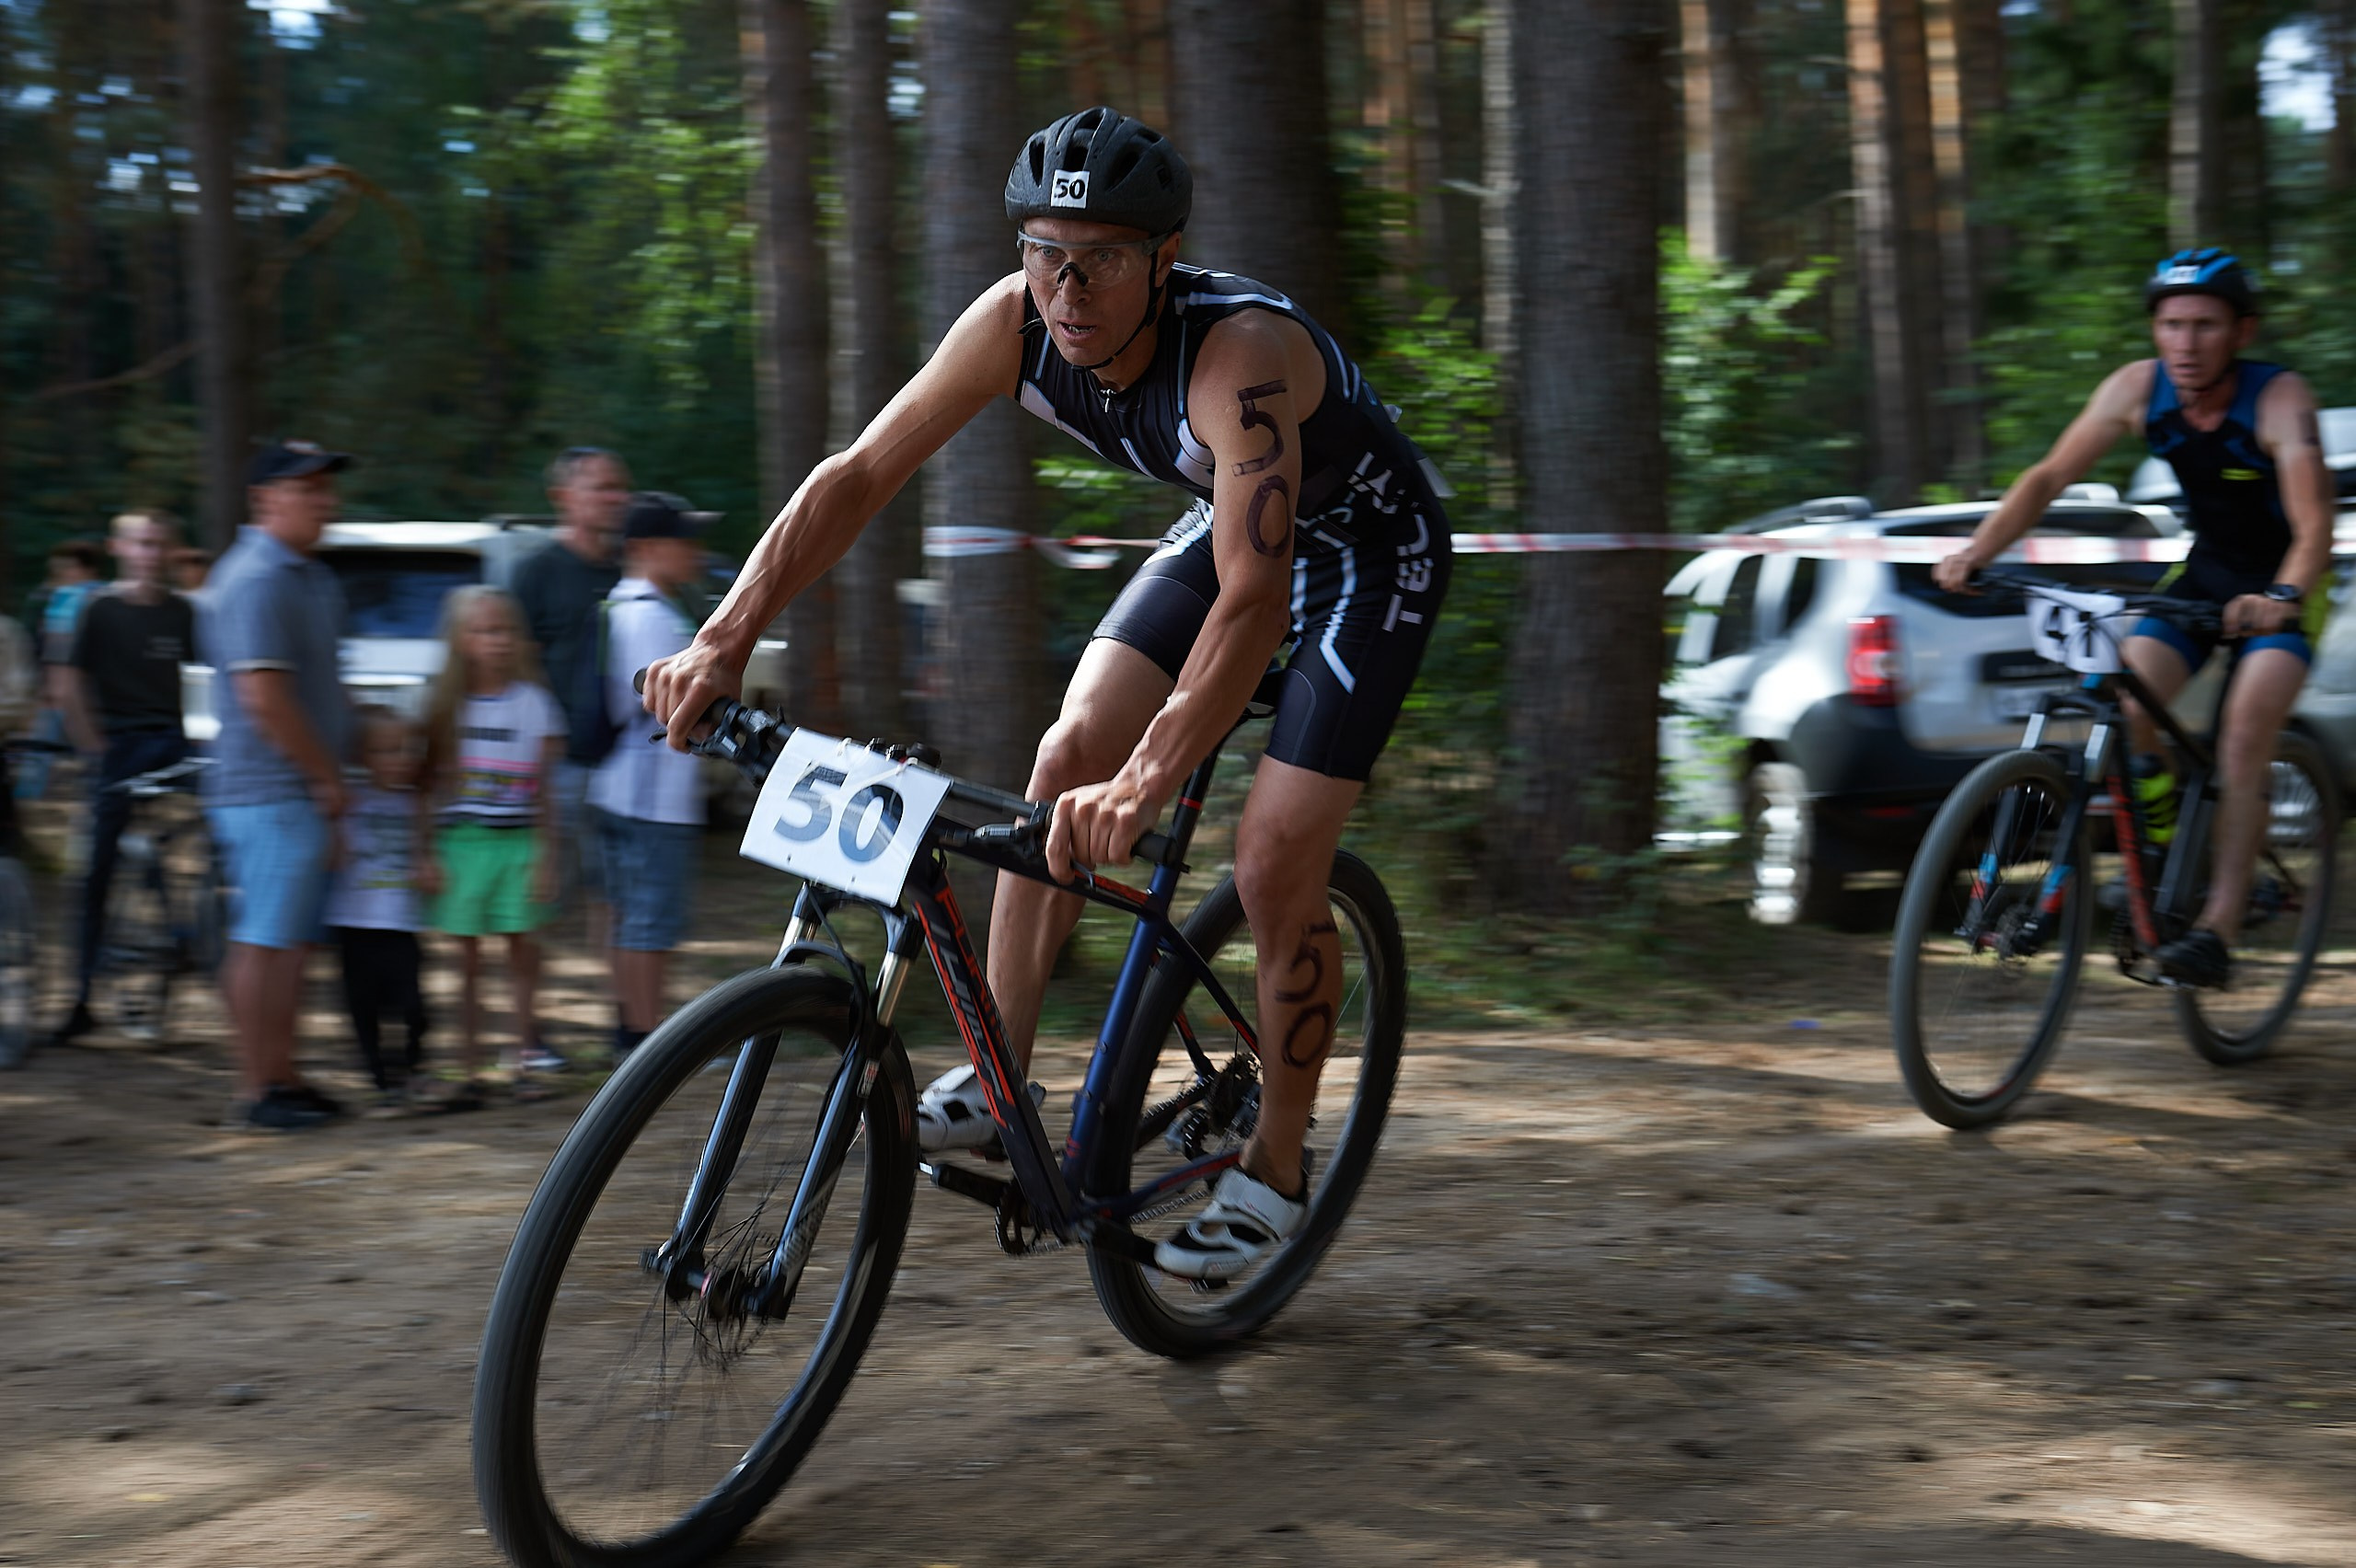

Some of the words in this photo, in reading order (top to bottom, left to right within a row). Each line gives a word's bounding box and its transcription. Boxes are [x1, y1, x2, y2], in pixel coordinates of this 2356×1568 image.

[1054, 178, 1086, 199] 50
[1231, 379, 1288, 559] 50
[773, 765, 905, 863] 50
[1275, 920, 1338, 1068] 50
